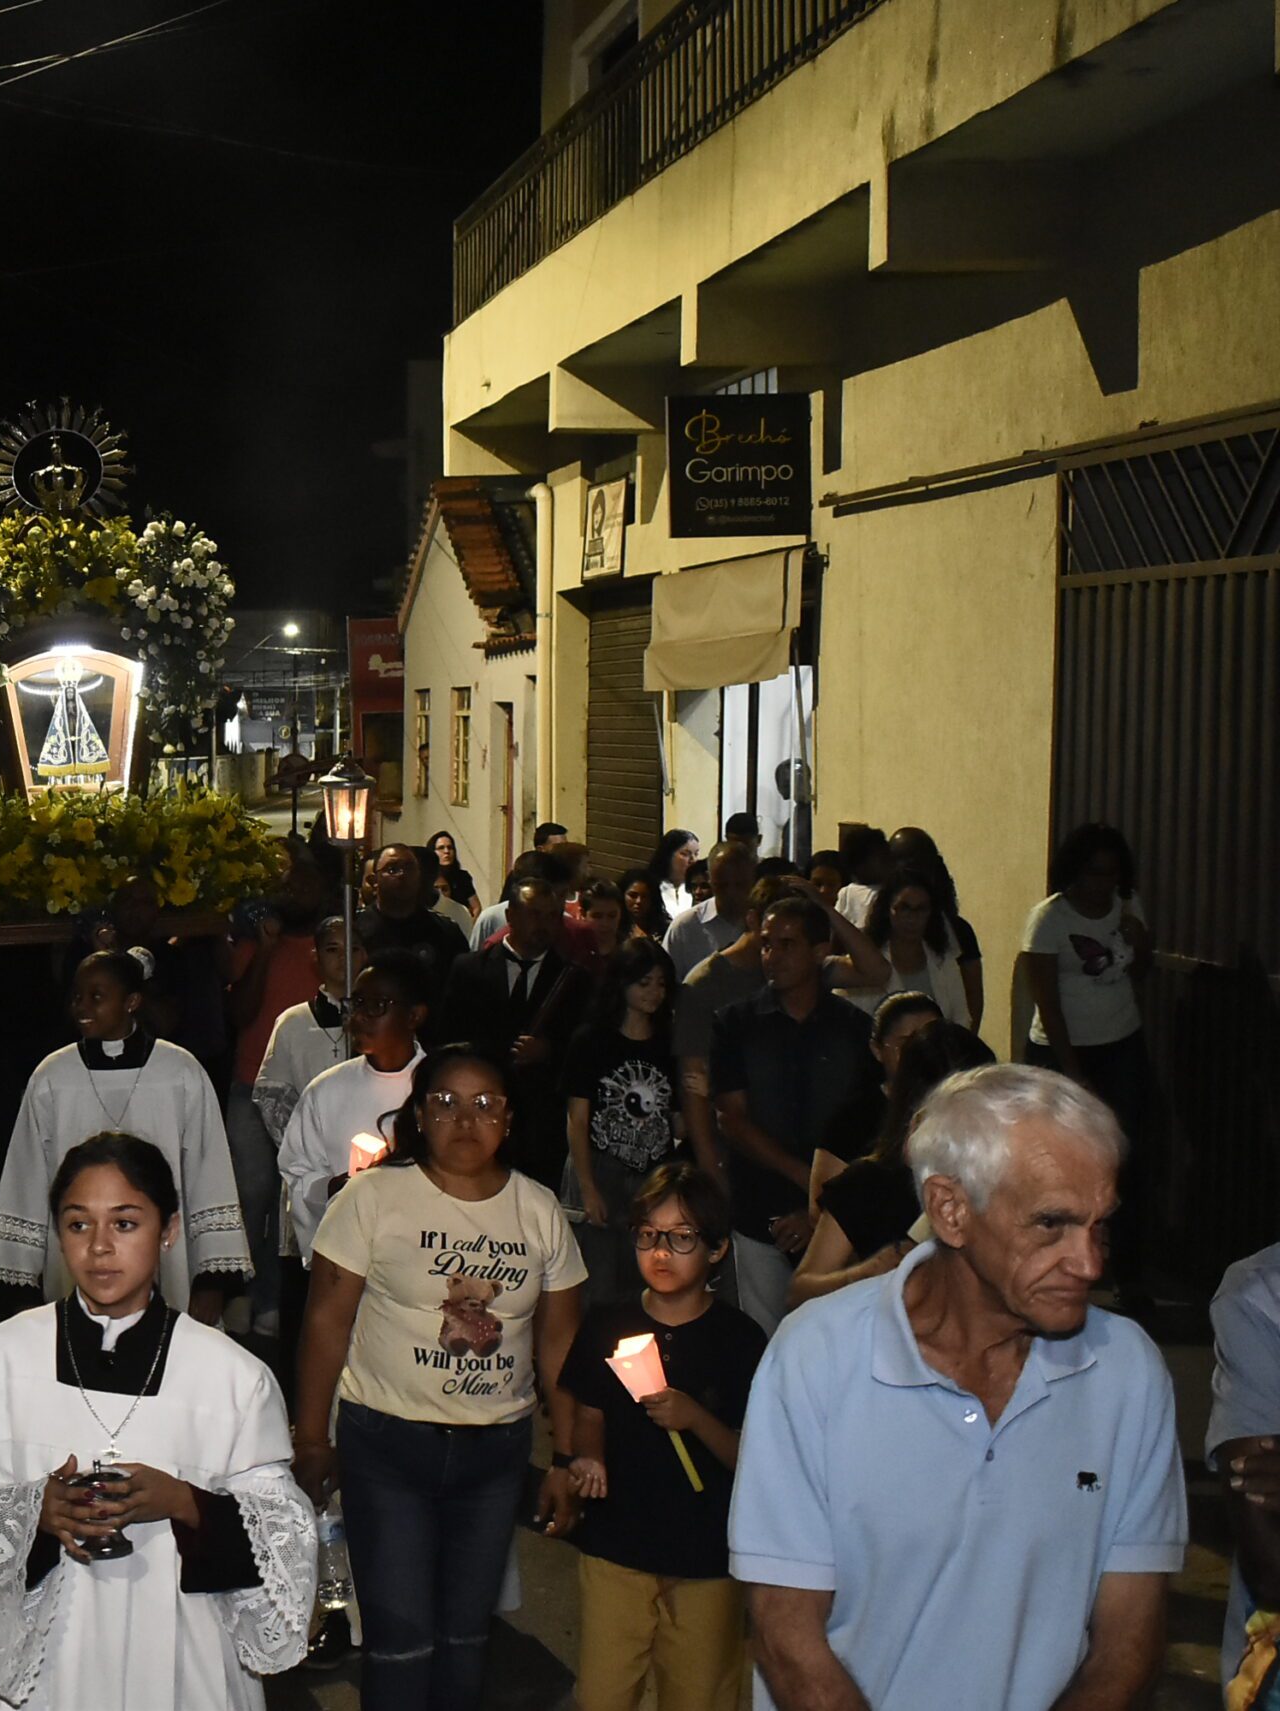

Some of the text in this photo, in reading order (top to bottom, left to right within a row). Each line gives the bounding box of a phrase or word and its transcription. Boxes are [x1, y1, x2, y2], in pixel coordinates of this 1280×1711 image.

[685, 458, 793, 489] Garimpo
[420, 1231, 527, 1258] If I call you
[428, 1251, 528, 1291] Darling
[413, 1347, 514, 1375] Will you be
